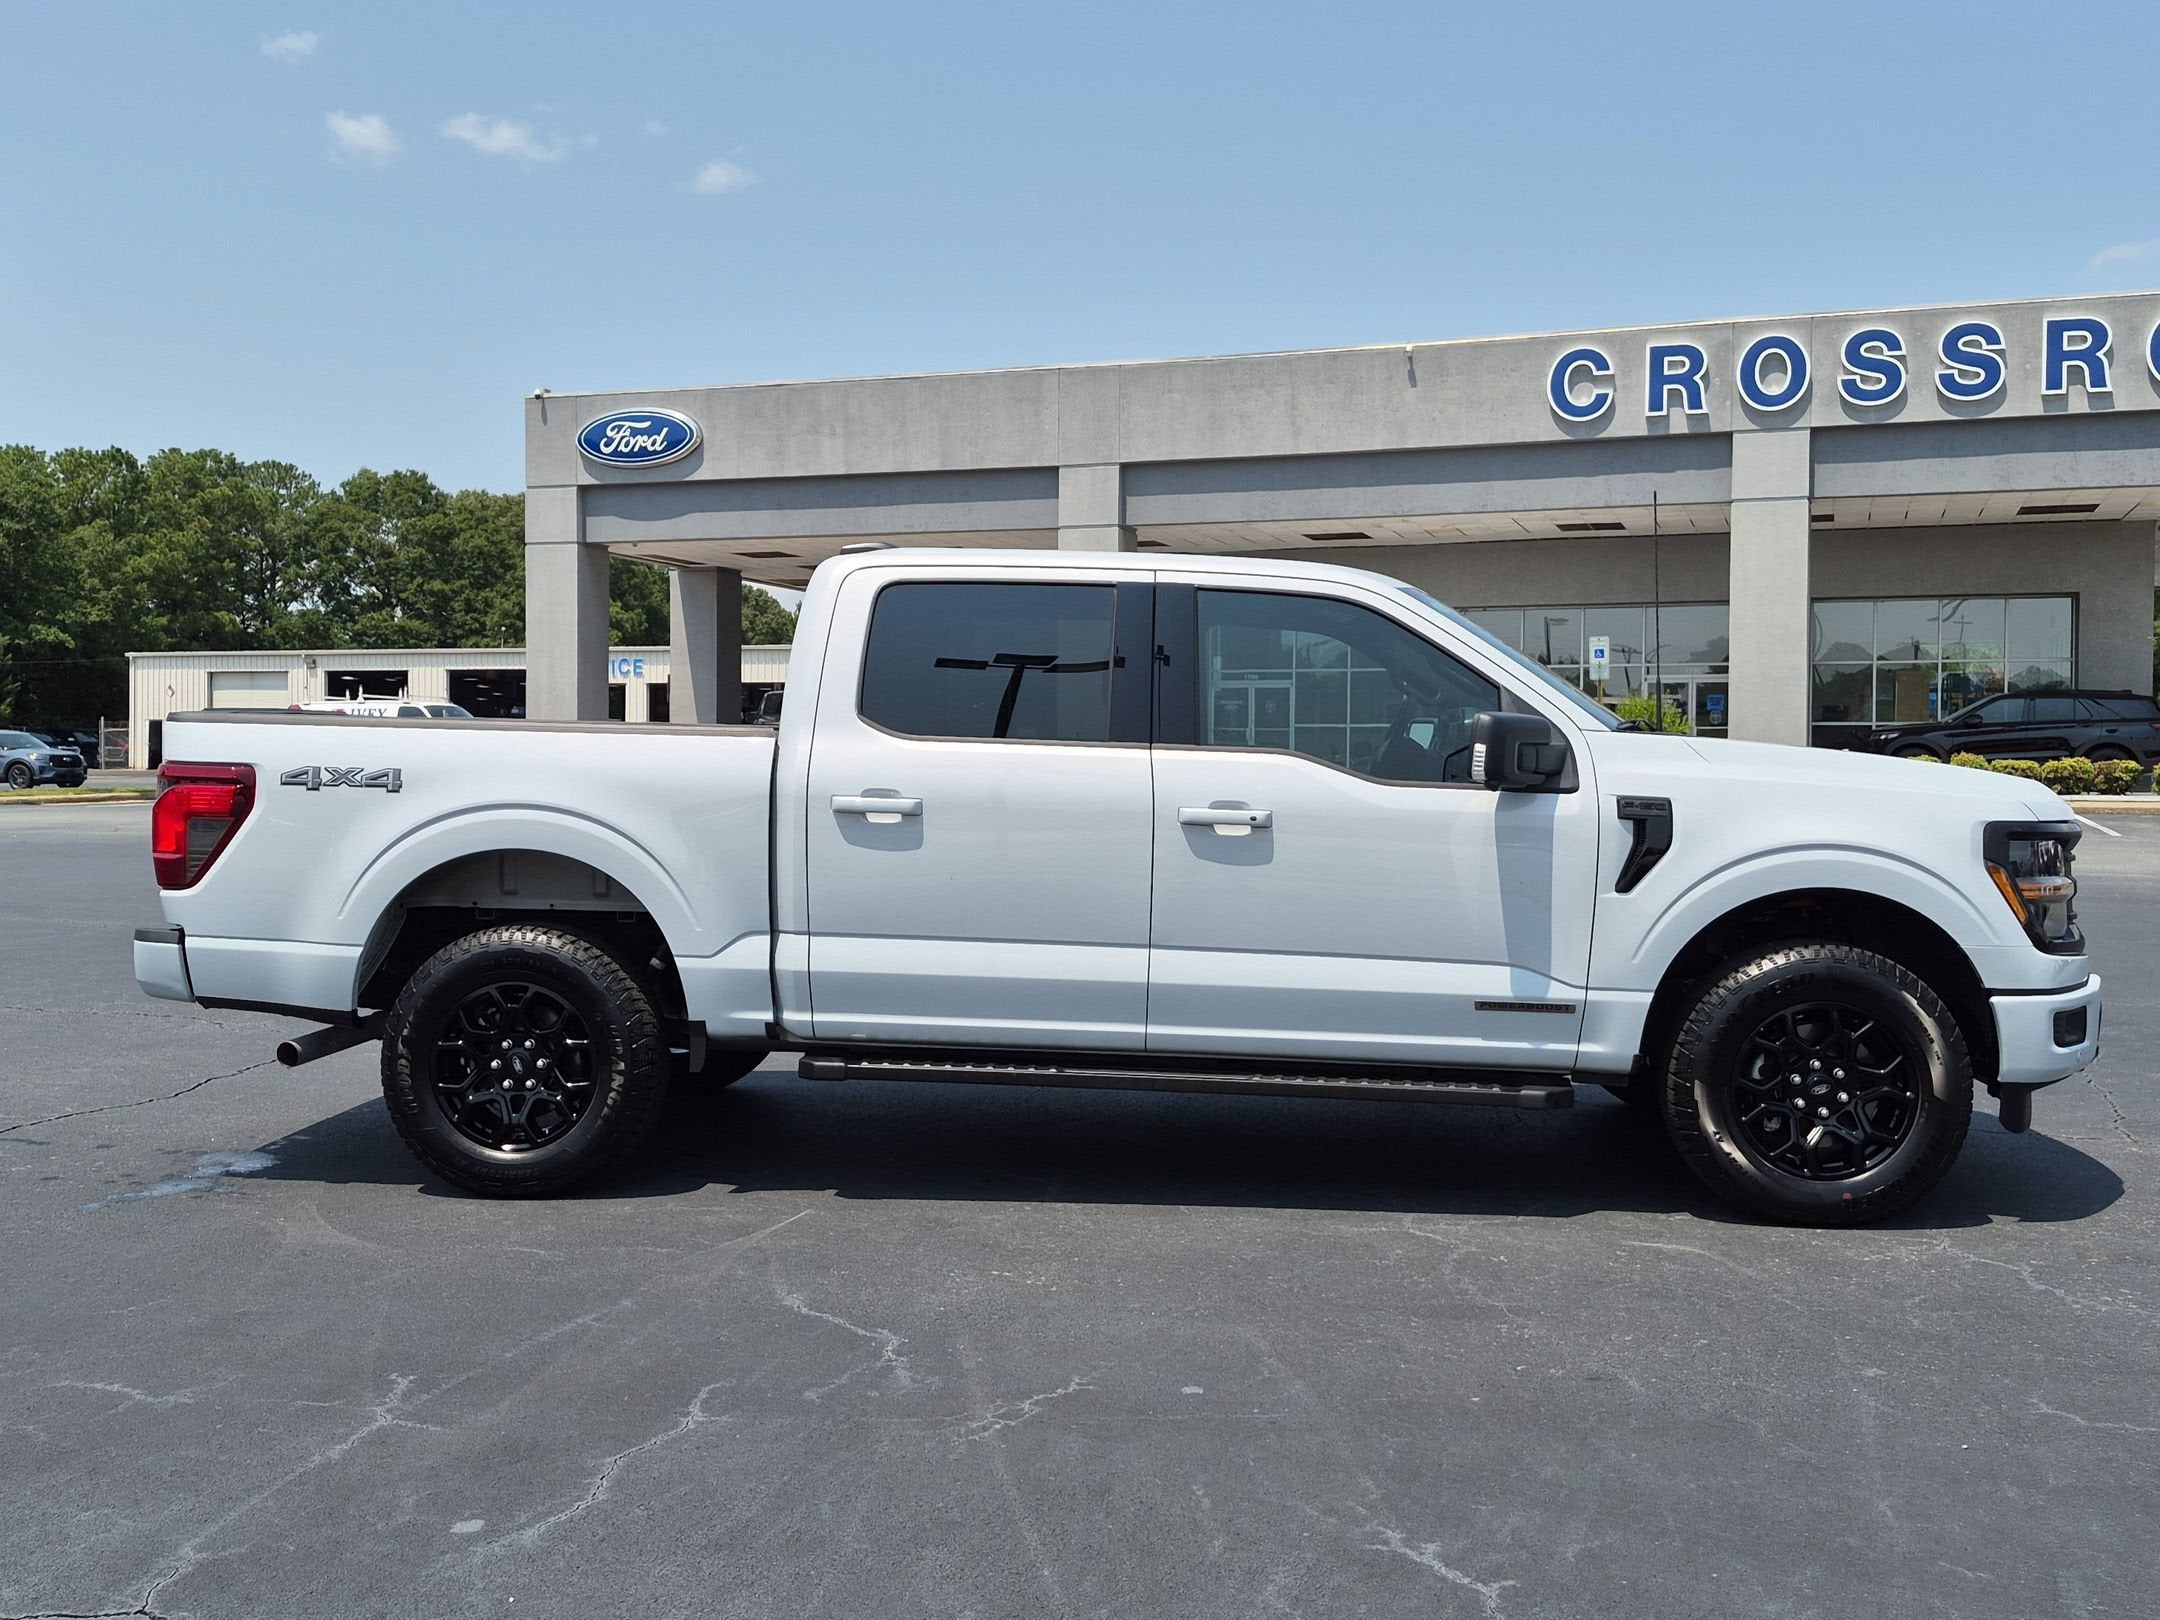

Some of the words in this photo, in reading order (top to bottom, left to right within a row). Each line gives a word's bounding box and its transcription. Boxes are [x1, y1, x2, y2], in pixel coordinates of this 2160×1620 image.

[1547, 316, 2160, 423] CROSSR
[600, 420, 669, 454] Ford
[611, 658, 644, 677] ICE
[1479, 1001, 1571, 1012] POWERBOOST
